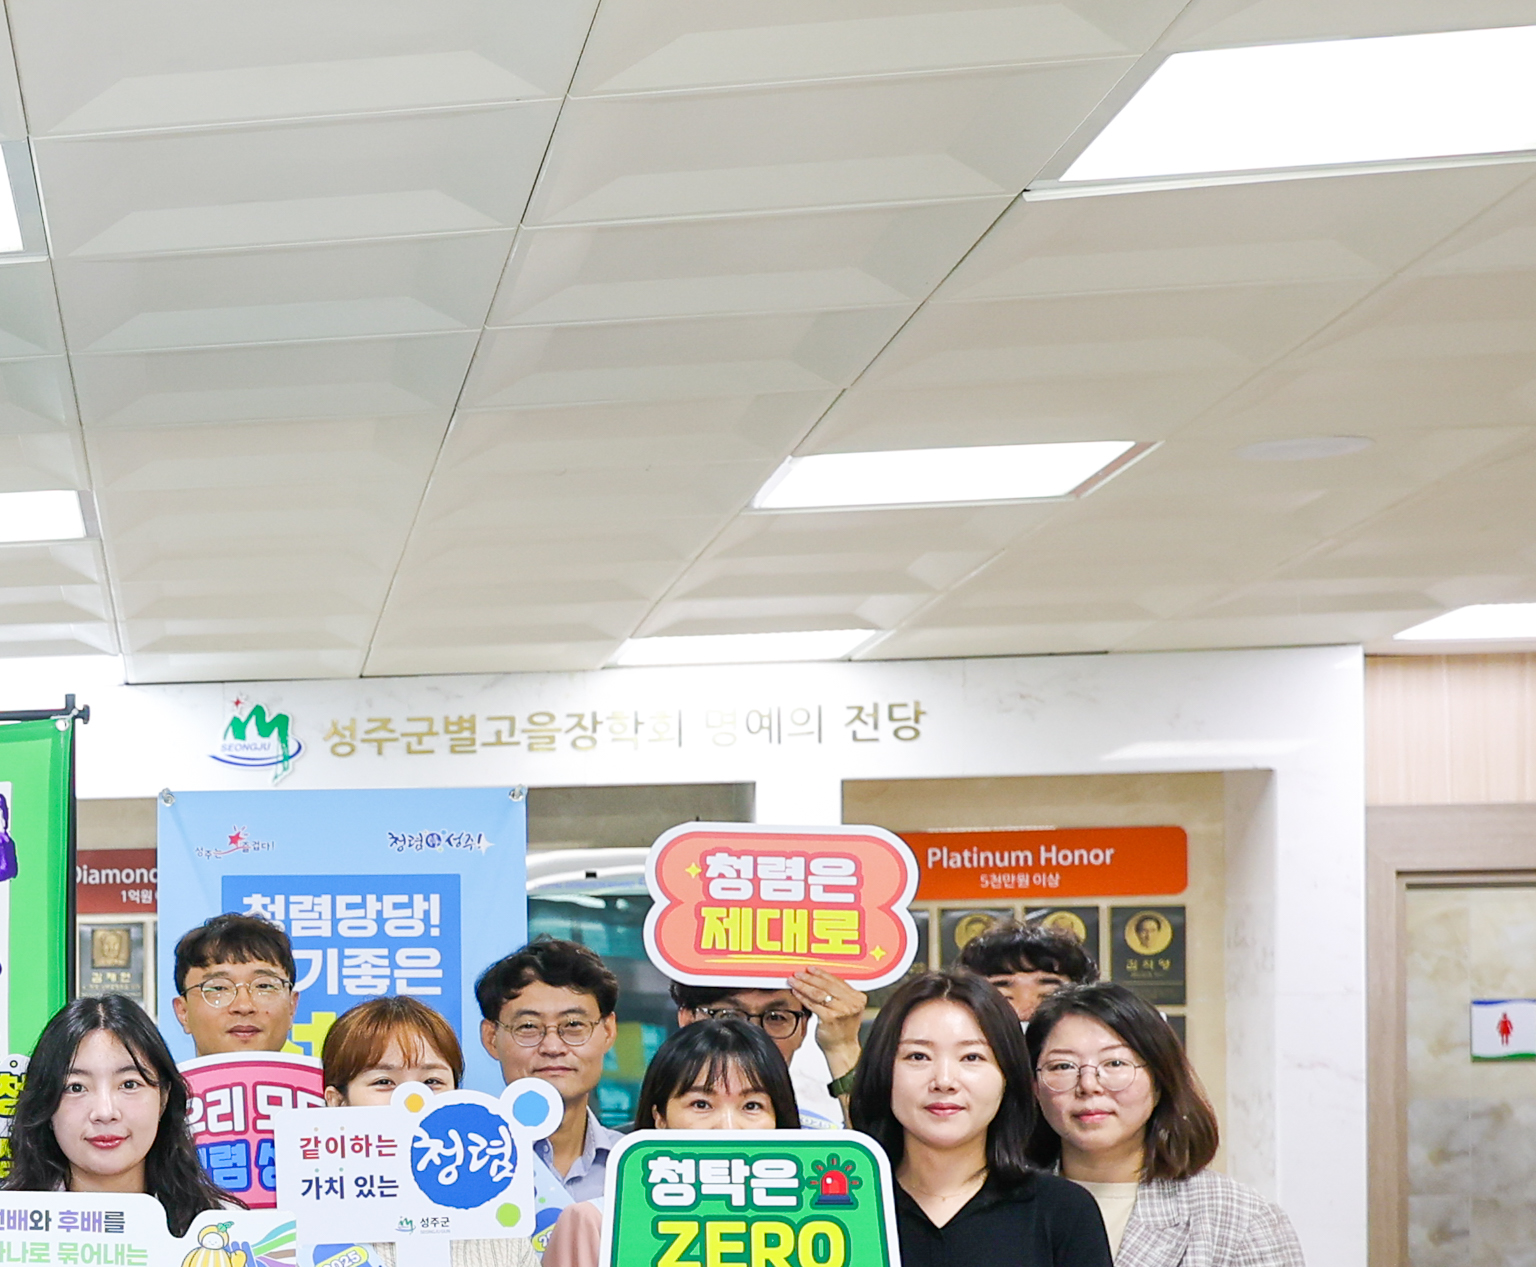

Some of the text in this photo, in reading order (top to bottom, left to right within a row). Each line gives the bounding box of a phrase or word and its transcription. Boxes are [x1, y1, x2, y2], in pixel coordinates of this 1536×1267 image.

[321, 699, 929, 760] 성주군별고을장학회 명예의 전당
[220, 740, 273, 754] SEONGJU
[194, 839, 276, 860] 성주는 즐겁다!
[926, 844, 1116, 870] Platinum Honor
[704, 851, 858, 903] 청렴은
[980, 871, 1061, 889] 5천만원 이상
[121, 888, 154, 905] 1억원
[241, 892, 443, 938] 청렴당당!
[699, 906, 862, 956] 제대로
[292, 946, 444, 996] 기좋은
[299, 1134, 399, 1160] 같이하는
[413, 1125, 519, 1185] 청렴
[197, 1142, 249, 1190] 렴
[301, 1174, 400, 1201] 가치 있는
[646, 1155, 800, 1207] 청탁은
[56, 1209, 126, 1234] 후배를
[420, 1216, 451, 1229] 성주군
[56, 1241, 149, 1266] 묶어내는
